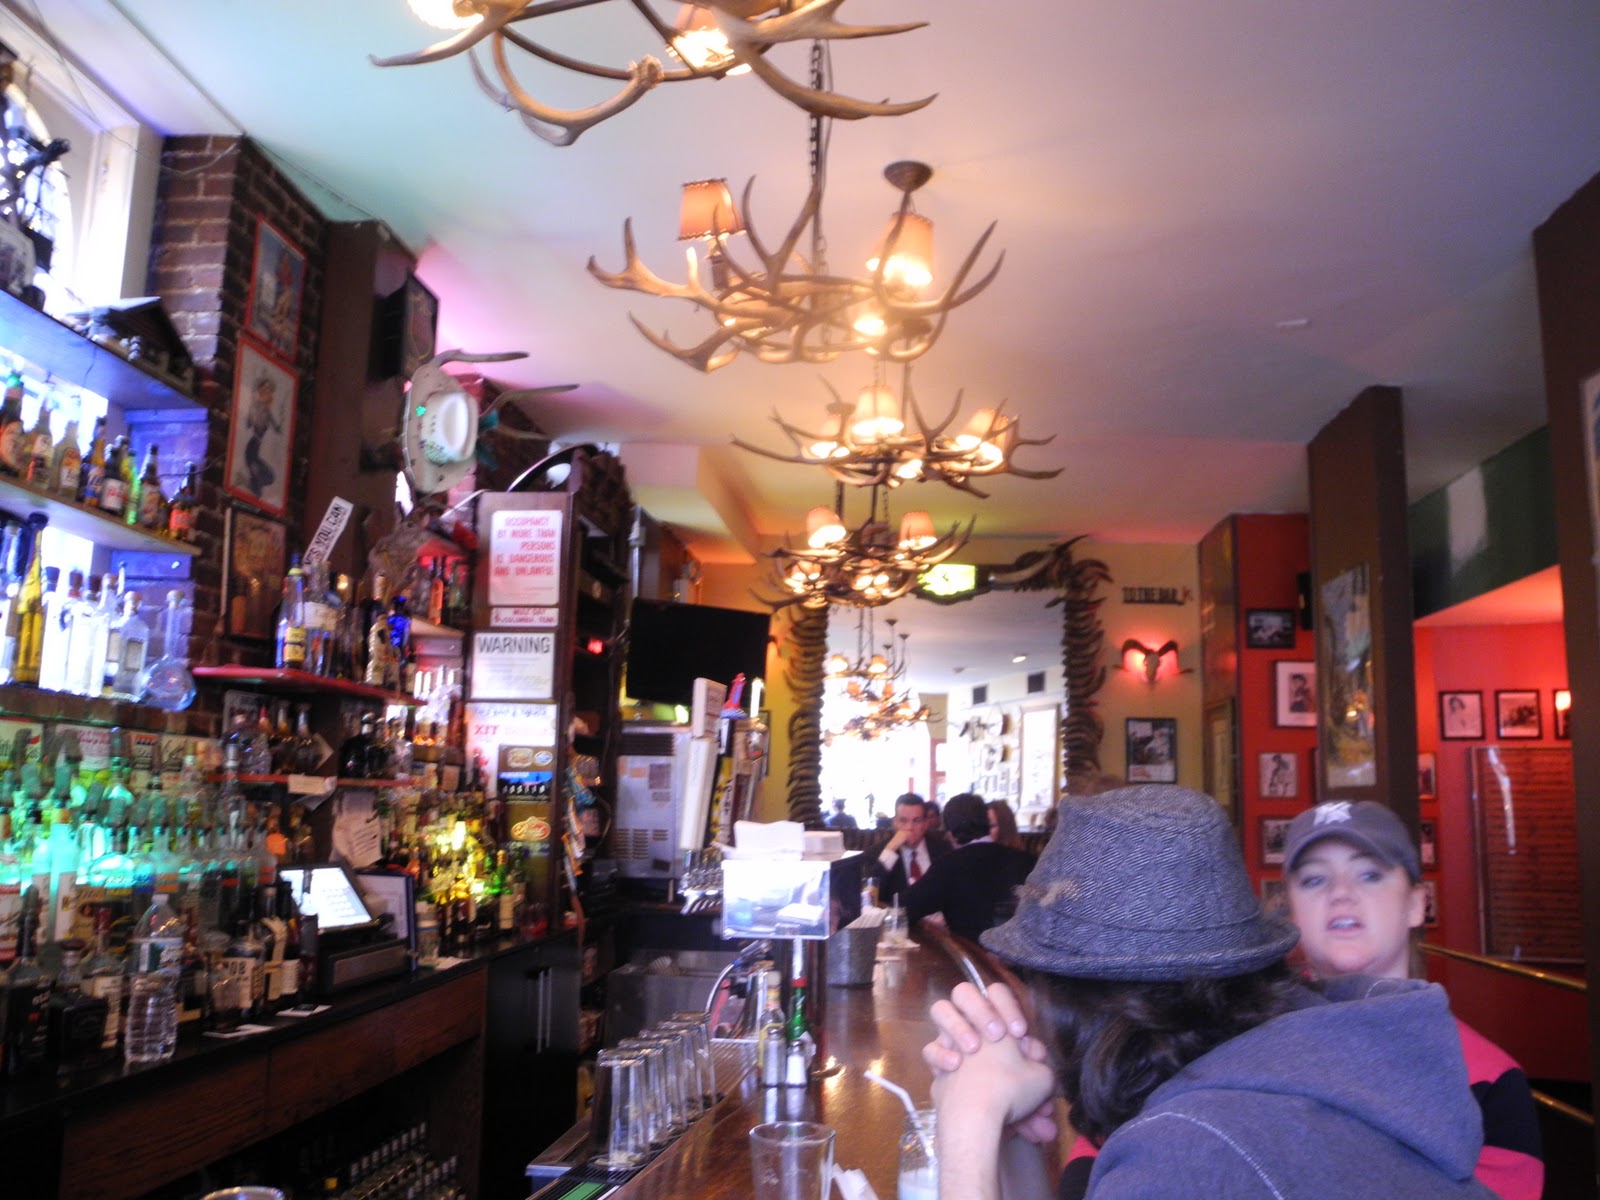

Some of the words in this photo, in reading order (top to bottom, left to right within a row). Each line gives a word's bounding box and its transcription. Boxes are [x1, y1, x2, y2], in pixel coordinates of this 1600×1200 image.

[314, 524, 333, 546] YOU
[326, 502, 345, 525] CAN
[511, 529, 532, 539] MORE
[537, 529, 556, 539] THAN
[510, 554, 554, 564] DANGEROUS
[478, 636, 551, 654] WARNING
